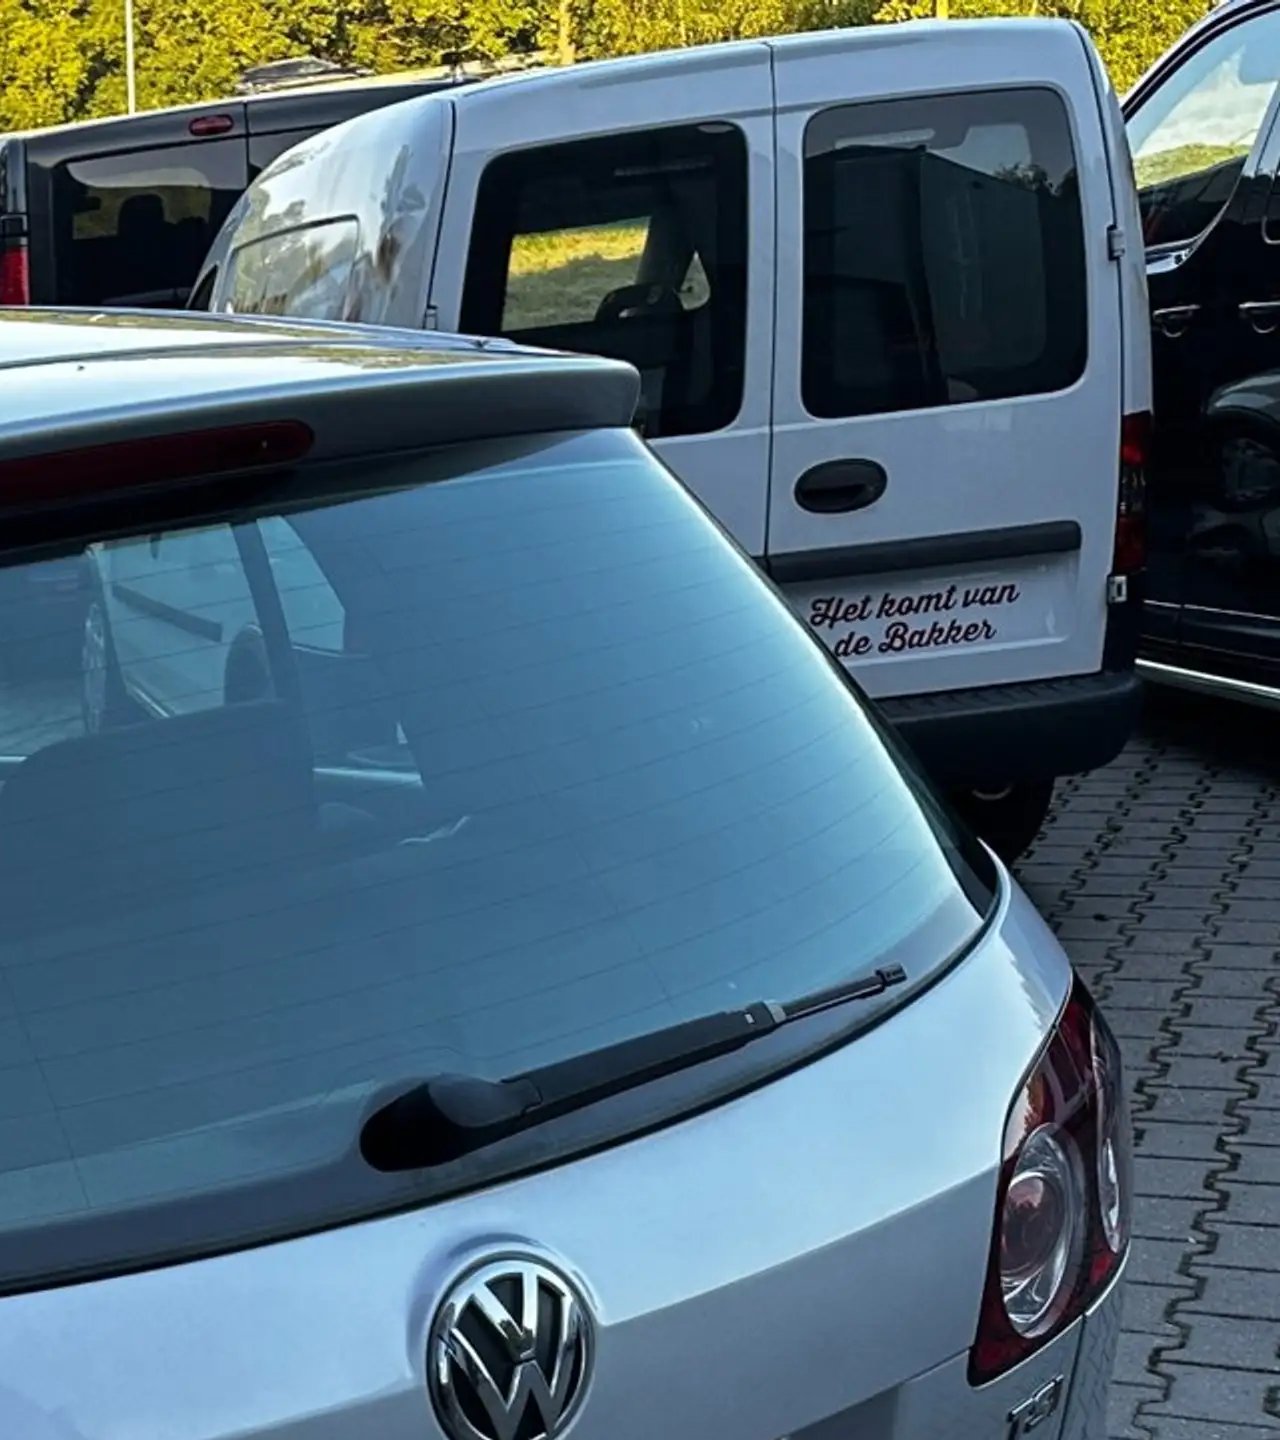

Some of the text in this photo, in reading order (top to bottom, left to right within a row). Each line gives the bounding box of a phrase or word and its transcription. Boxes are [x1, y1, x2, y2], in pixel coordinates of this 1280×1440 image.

[810, 583, 1020, 629] Het komt van
[834, 619, 997, 657] de Bakker
